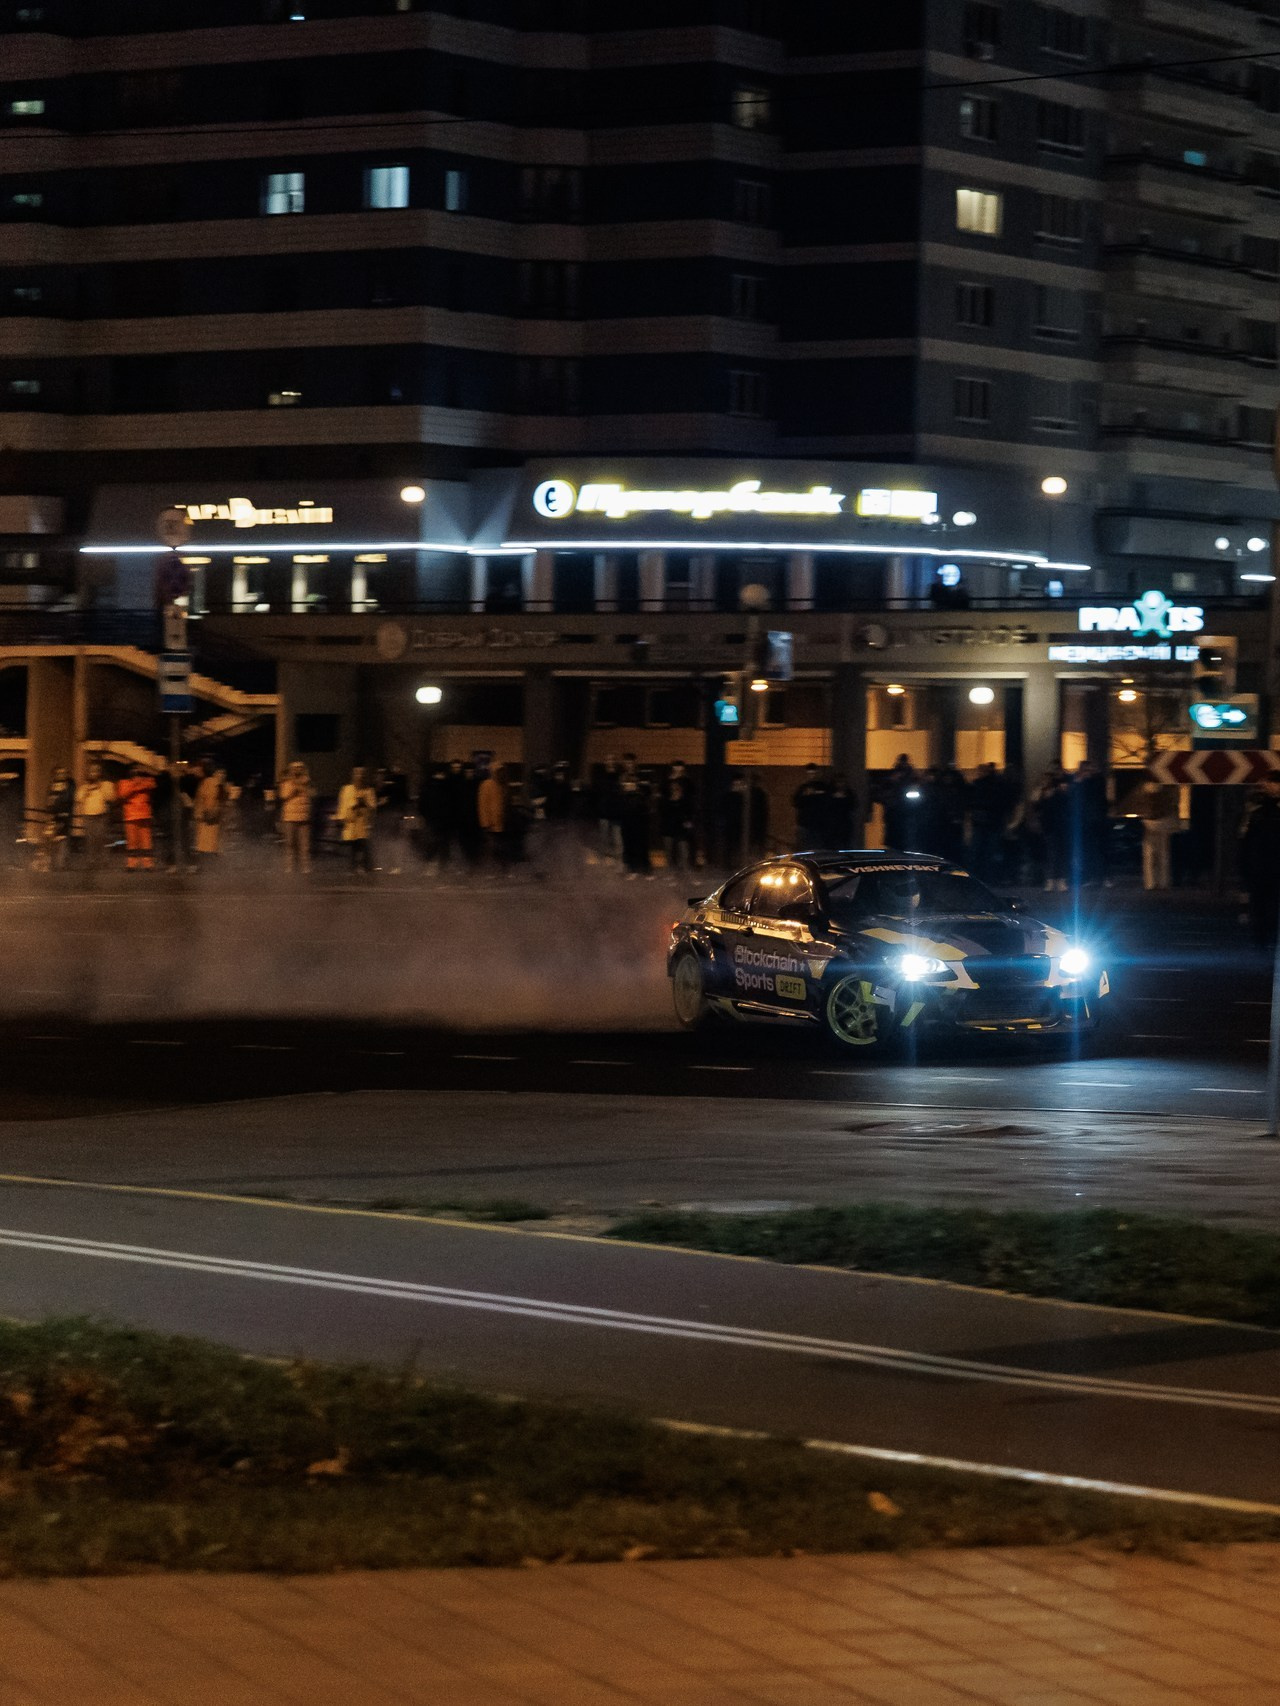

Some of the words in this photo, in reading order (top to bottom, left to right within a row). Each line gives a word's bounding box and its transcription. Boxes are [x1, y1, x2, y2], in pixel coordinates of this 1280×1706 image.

[734, 944, 799, 973] Blockchain
[735, 967, 775, 992] Sports
[780, 980, 802, 995] DRIFT
